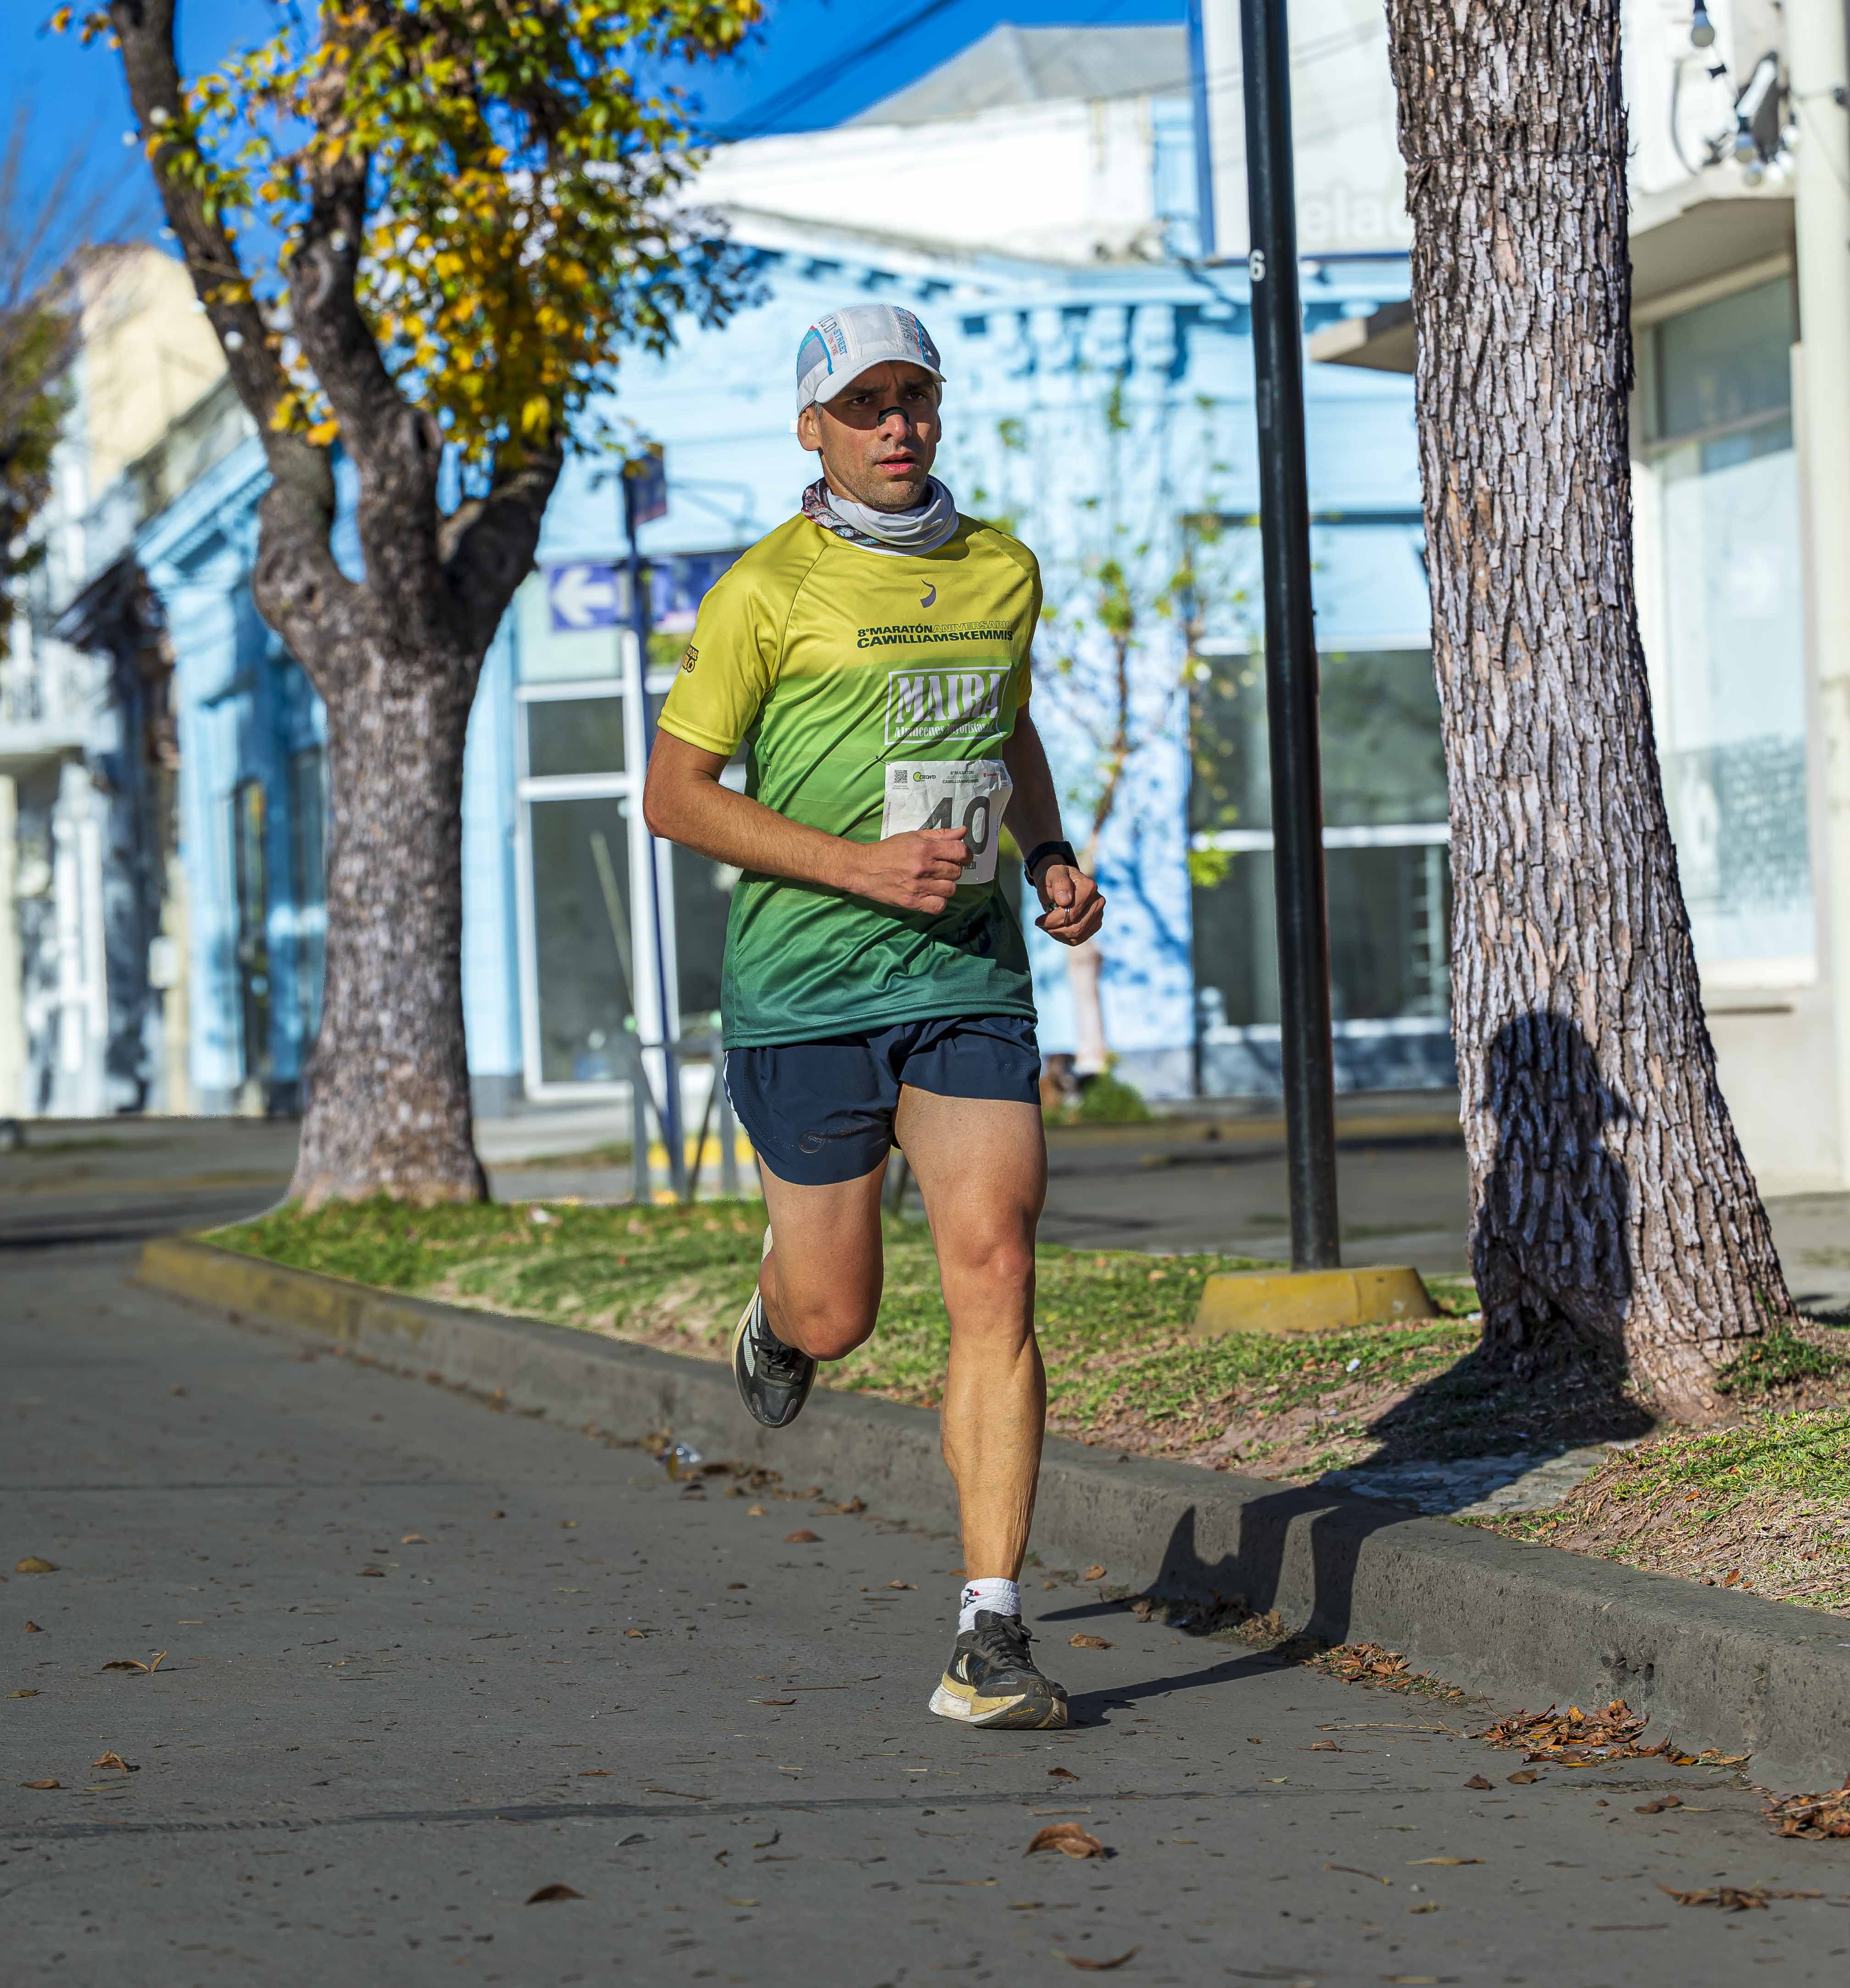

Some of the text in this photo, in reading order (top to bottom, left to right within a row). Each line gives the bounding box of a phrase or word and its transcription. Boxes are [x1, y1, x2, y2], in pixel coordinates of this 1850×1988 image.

[1249, 249, 1265, 282] 6
[833, 329, 847, 355] STREET
[895, 674, 1000, 724] MAIRA
[894, 725, 945, 738] Almacenes
[918, 796, 991, 855] 40
